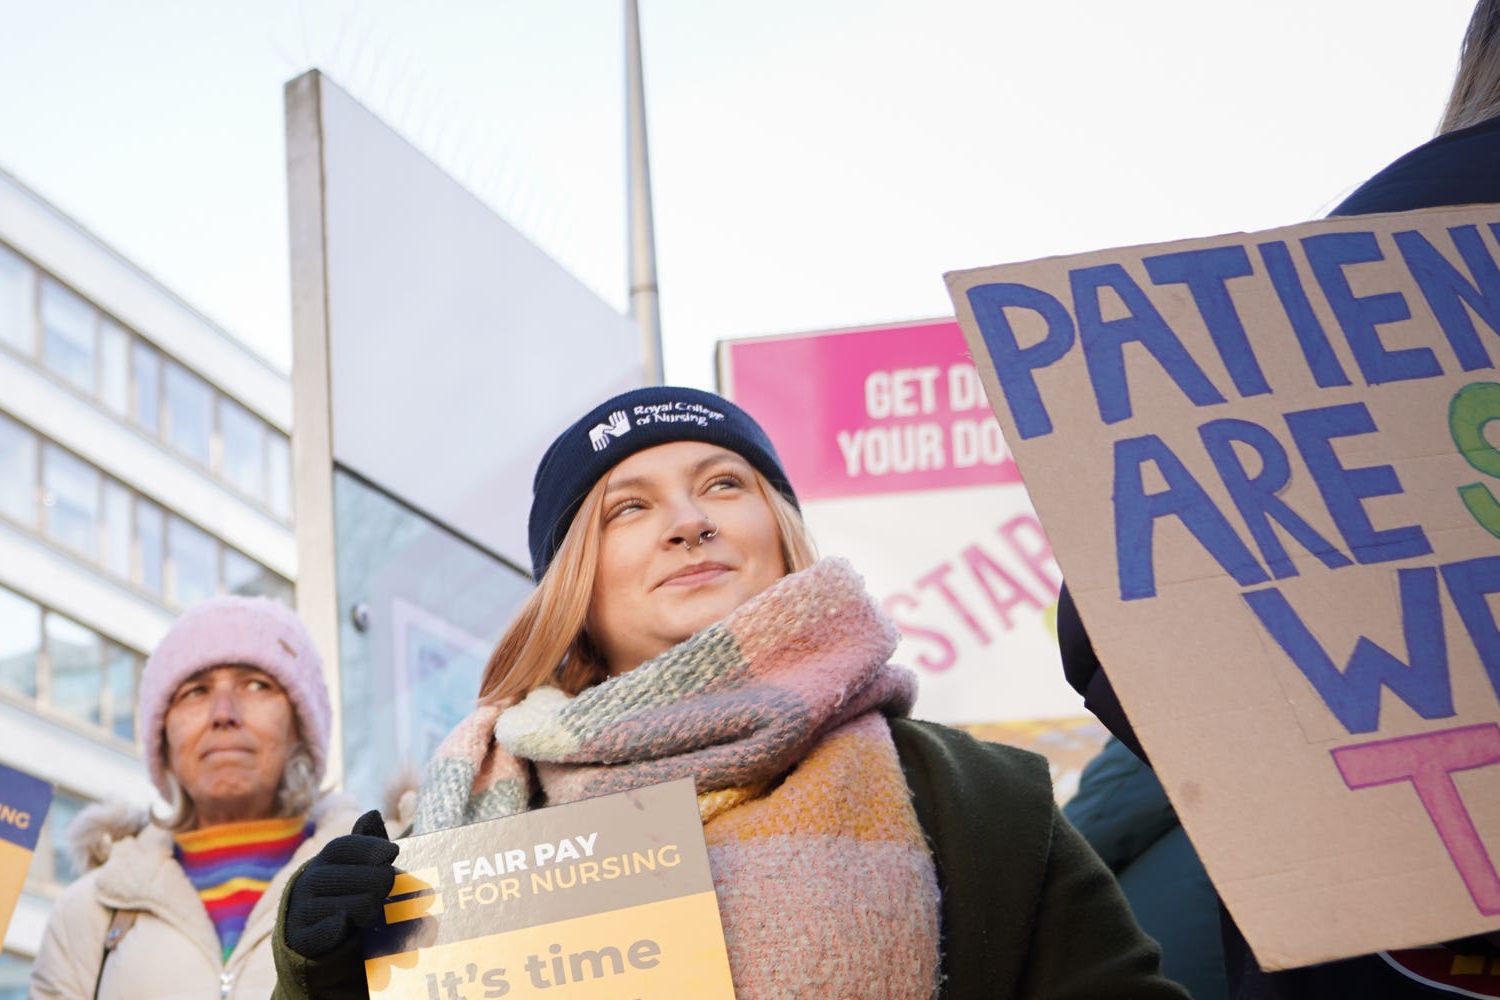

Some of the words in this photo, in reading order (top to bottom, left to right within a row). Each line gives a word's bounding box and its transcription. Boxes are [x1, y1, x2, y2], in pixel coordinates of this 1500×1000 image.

[965, 222, 1500, 440] PATIEN
[633, 402, 672, 416] Royal
[675, 402, 725, 421] College
[636, 414, 651, 426] of
[654, 413, 708, 427] Nursing
[864, 364, 941, 420] GET
[836, 420, 946, 478] YOUR
[952, 416, 1014, 468] DO
[1111, 402, 1434, 601] ARE
[452, 848, 527, 883] FAIR
[533, 832, 598, 867] PAY
[457, 877, 520, 910] FOR
[531, 844, 682, 895] NURSING
[525, 937, 661, 990] time
